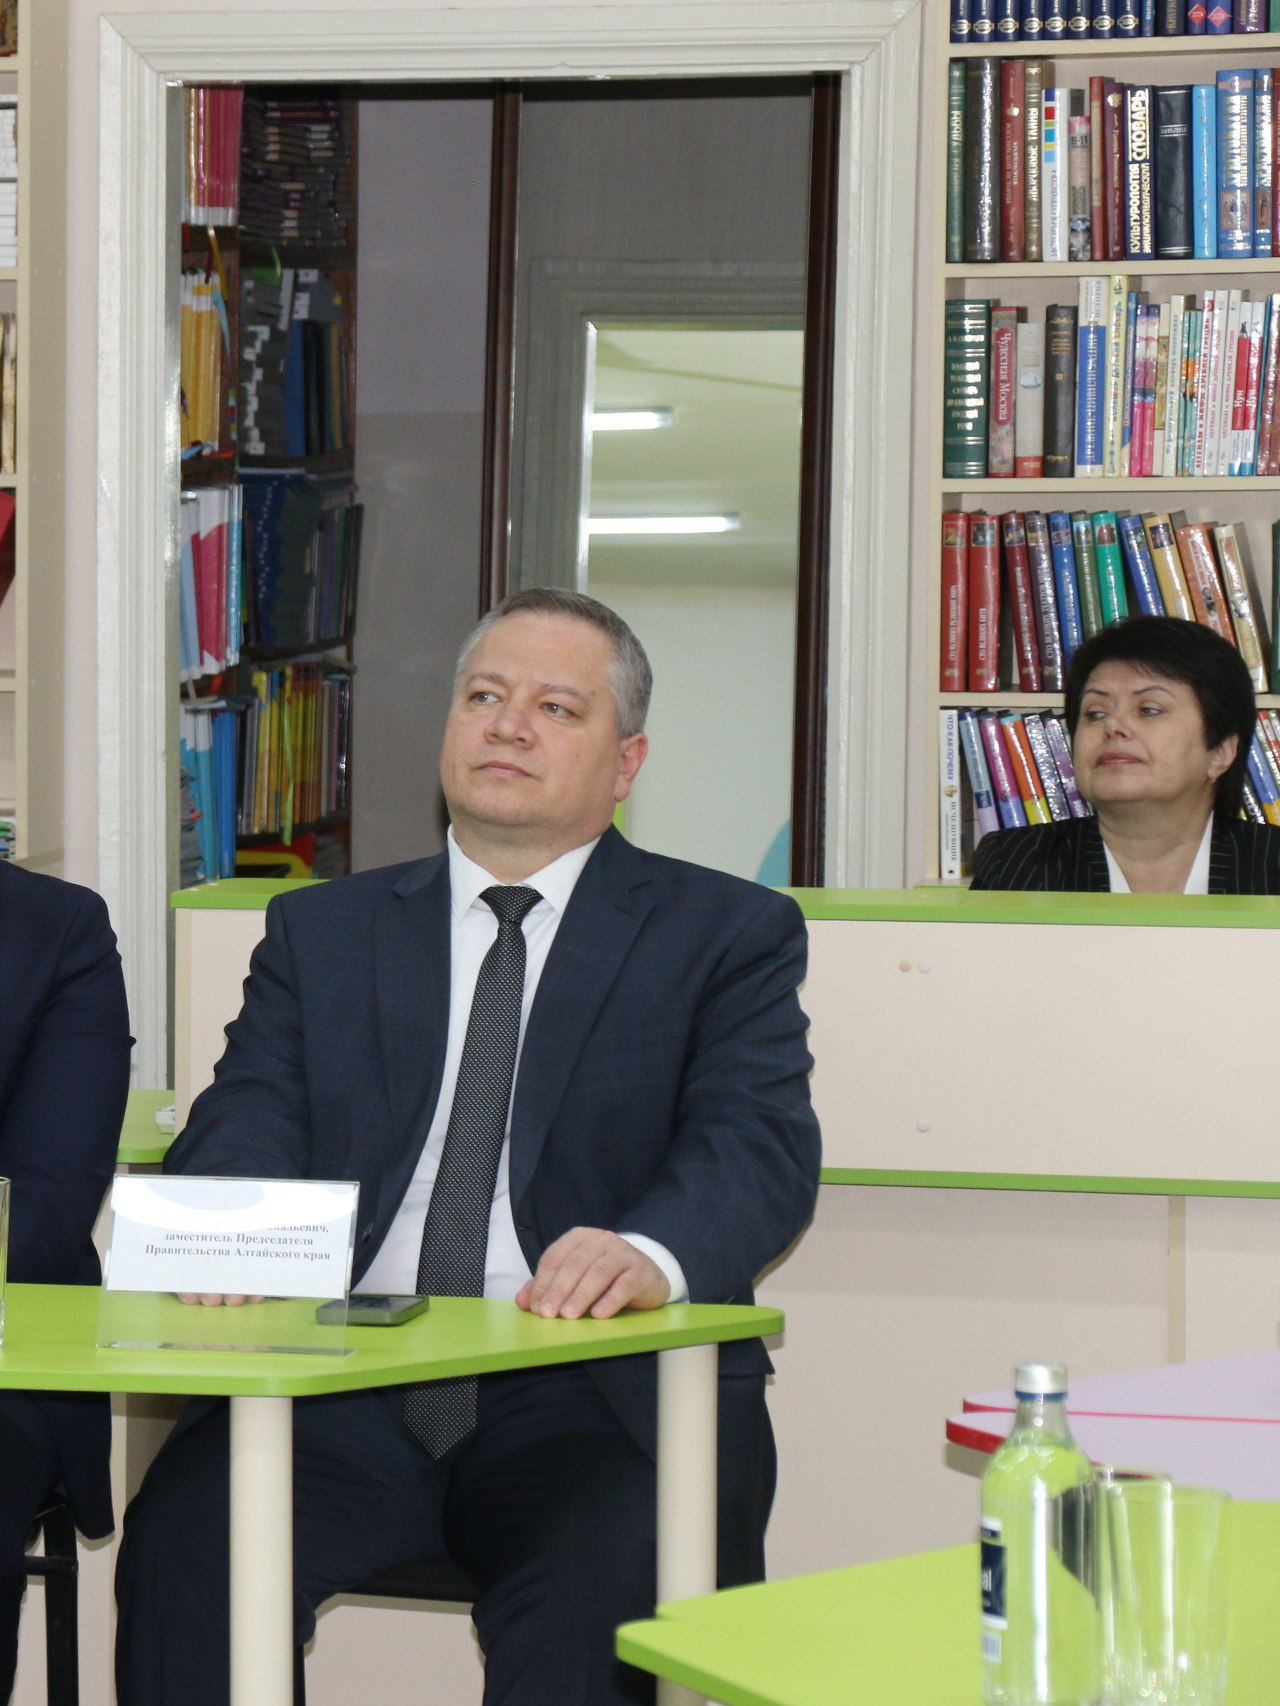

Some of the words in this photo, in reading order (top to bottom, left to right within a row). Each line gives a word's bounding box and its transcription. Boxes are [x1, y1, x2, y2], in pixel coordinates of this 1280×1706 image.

[1027, 108, 1038, 142] ТАЙНЫ
[1131, 90, 1147, 161] СЛОВАРЬ
[1128, 164, 1141, 254] КУЛЬТУРОЛОГИЯ
[1141, 163, 1152, 254] ЭНЦИКЛОПЕДИЧЕСКИЙ
[1202, 318, 1211, 349] ГРЕЦИИ
[998, 332, 1012, 380] Чудесная
[1086, 334, 1098, 412] ЦИВИЛИЗАЦИИ
[1200, 352, 1209, 389] ДРЕВНЕЙ
[998, 382, 1011, 421] Москва
[1199, 392, 1207, 421] МИФЫ
[1234, 390, 1244, 408] Кун
[1246, 389, 1255, 407] Кун
[1195, 430, 1204, 469] ЛЕГЕНДЫ
[1047, 645, 1057, 659] СТО
[145, 1244, 230, 1257] Правительства
[234, 1247, 300, 1260] Алтайского
[303, 1252, 330, 1262] края
[164, 1233, 233, 1243] заместитель
[236, 1233, 313, 1246] Председателя
